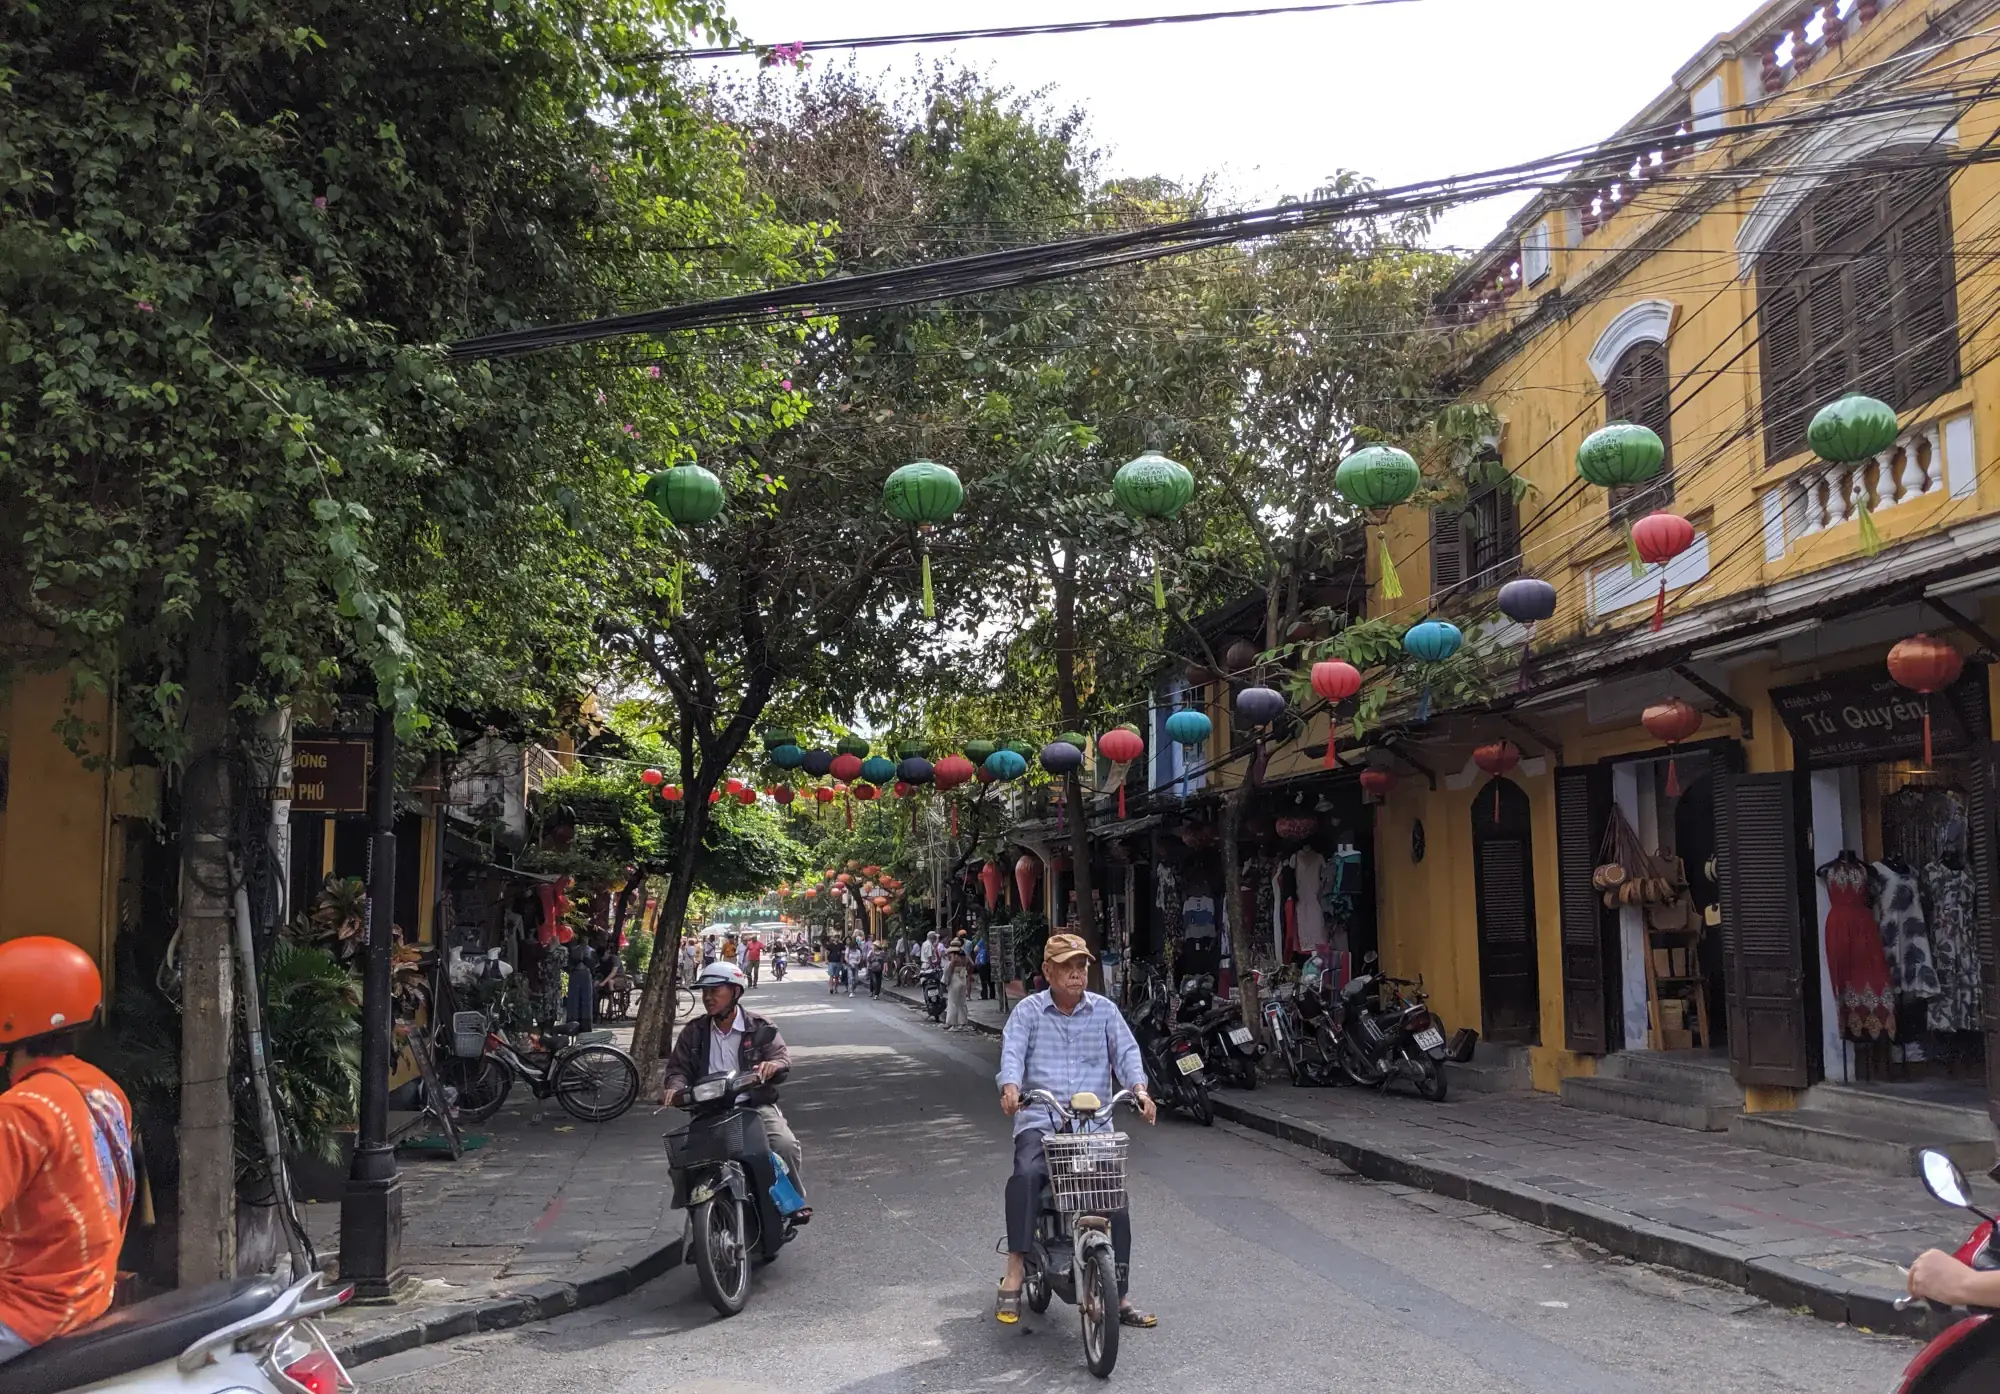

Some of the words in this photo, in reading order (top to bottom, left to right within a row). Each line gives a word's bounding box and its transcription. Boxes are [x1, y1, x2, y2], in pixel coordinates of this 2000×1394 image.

[1375, 461, 1409, 469] ROASTERY
[1801, 709, 1838, 736] Tú
[1842, 696, 1926, 731] Quyên
[298, 780, 325, 801] PHÚ
